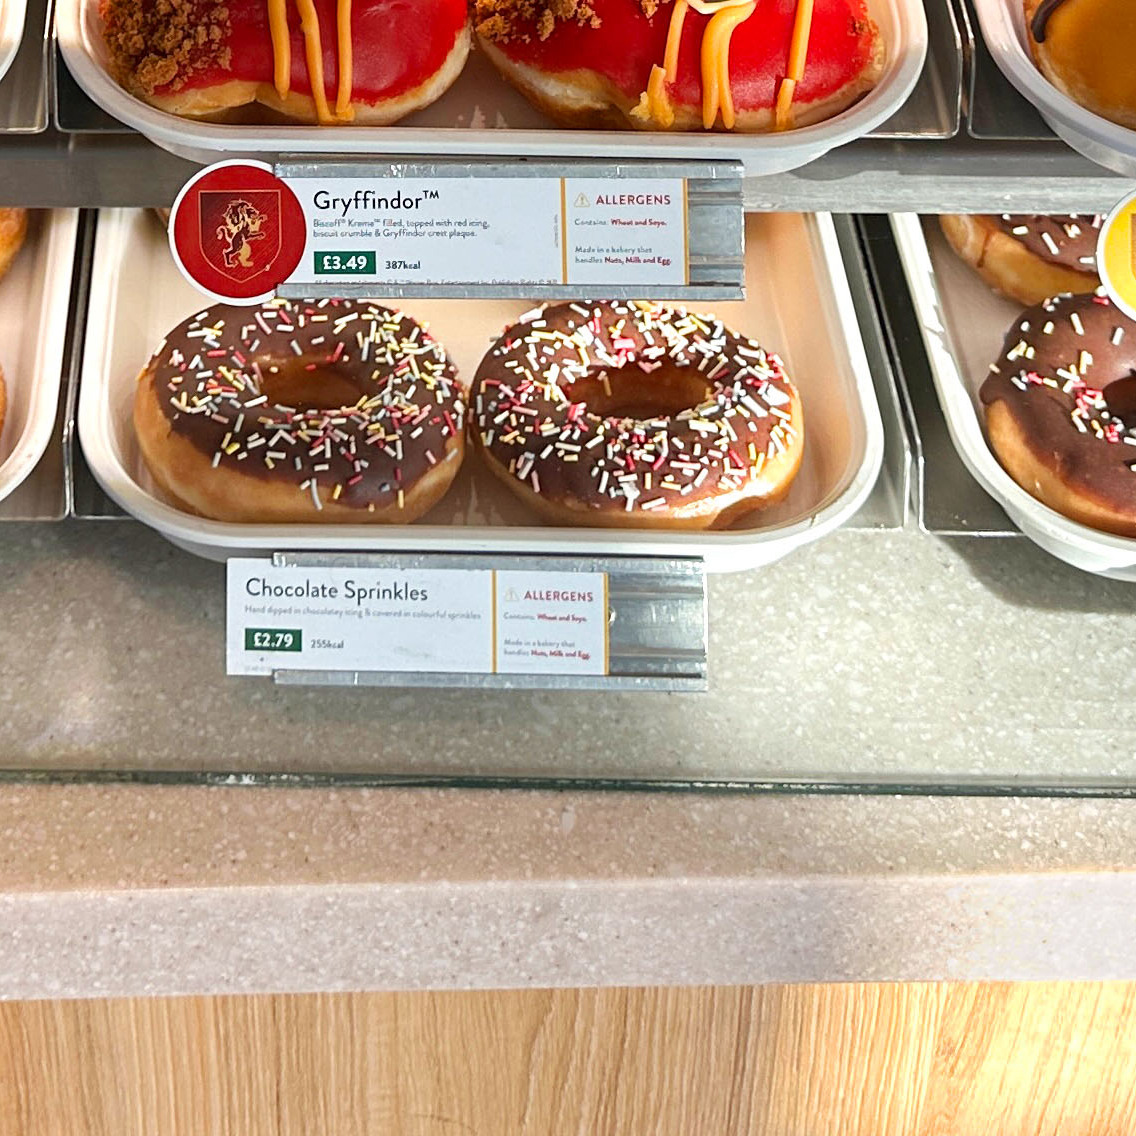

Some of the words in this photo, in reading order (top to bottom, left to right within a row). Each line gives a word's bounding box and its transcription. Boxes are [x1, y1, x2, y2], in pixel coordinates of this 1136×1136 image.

[596, 195, 671, 205] ALLERGENS
[323, 255, 367, 270] £3.49
[385, 260, 421, 270] 387kcal
[245, 578, 338, 599] Chocolate
[344, 580, 428, 606] Sprinkles
[524, 591, 593, 603] ALLERGENS
[254, 632, 294, 648] £2.79
[311, 639, 344, 649] 255kcal
